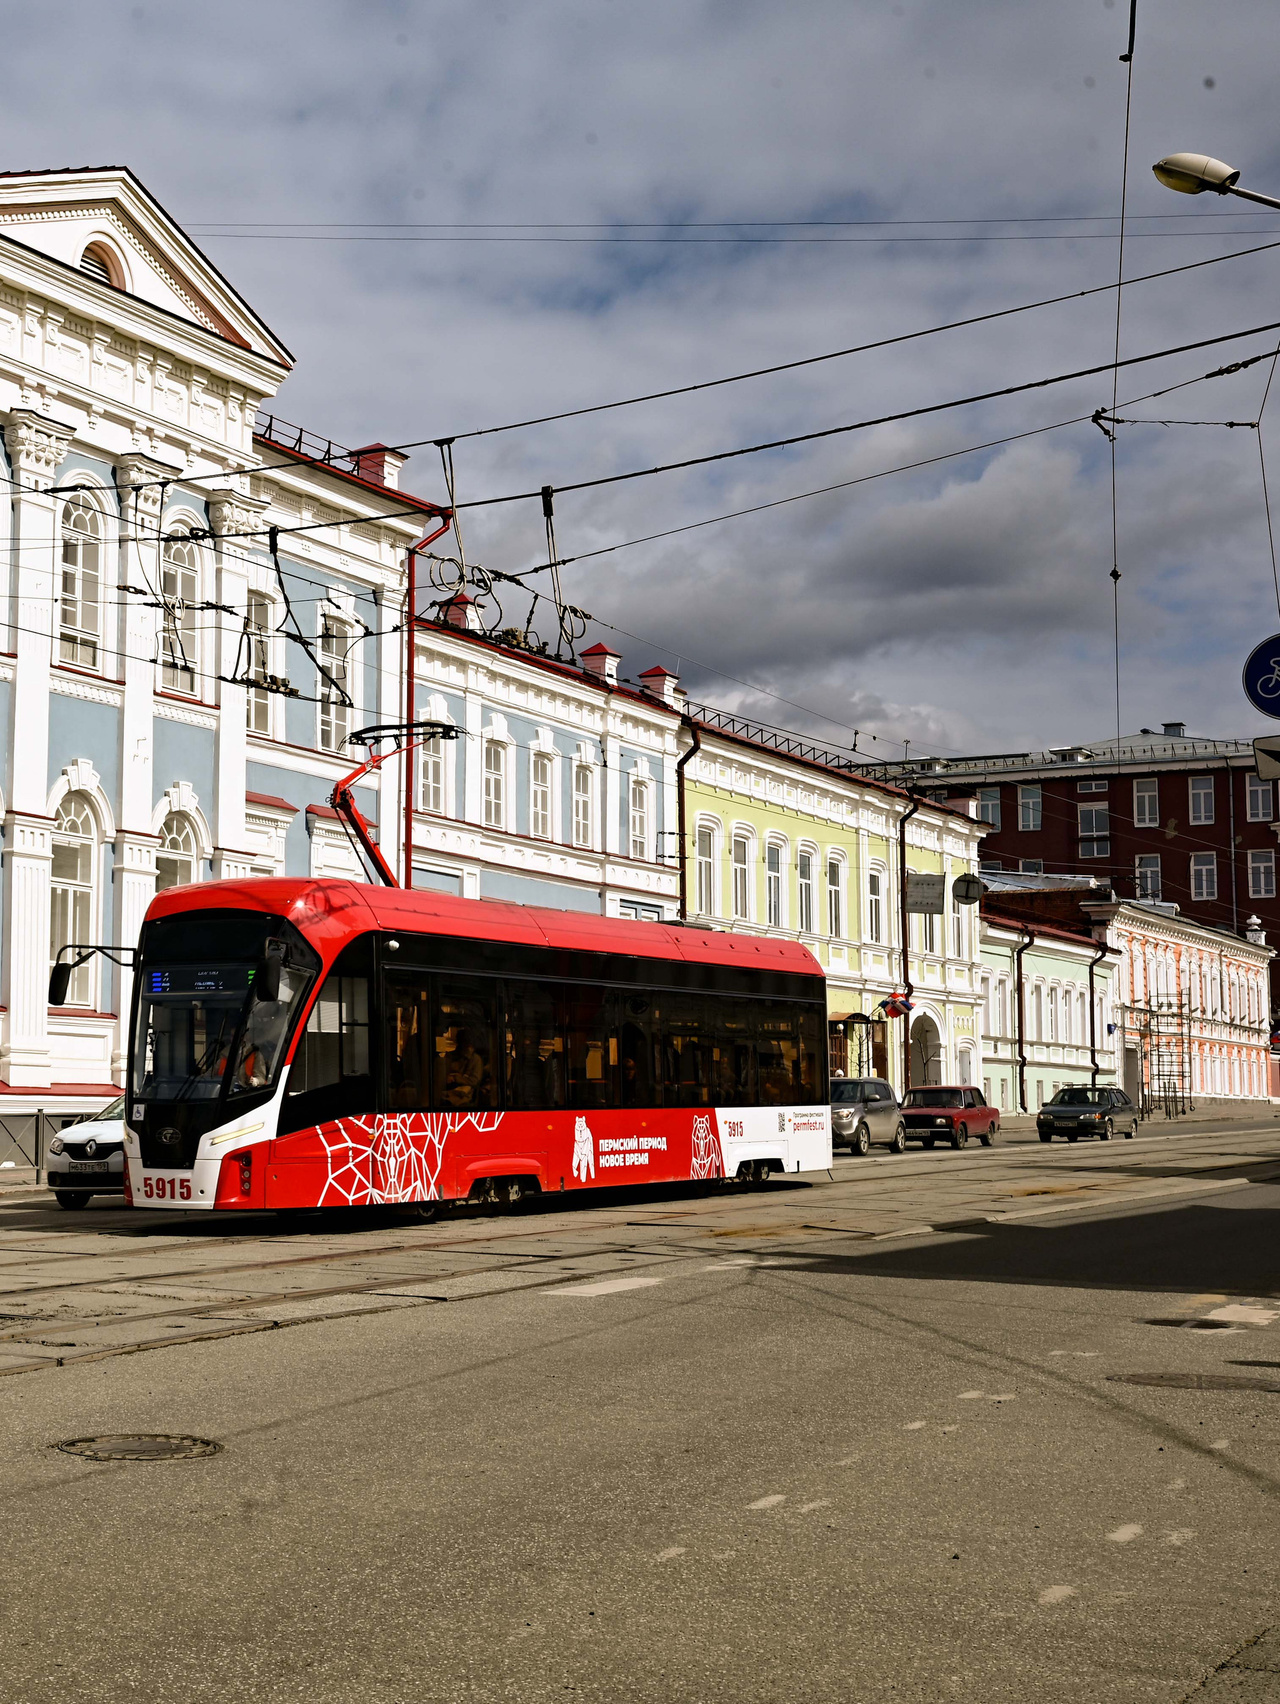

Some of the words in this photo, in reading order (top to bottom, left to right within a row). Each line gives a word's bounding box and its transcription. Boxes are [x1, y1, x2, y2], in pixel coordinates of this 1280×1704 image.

[728, 1121, 744, 1137] 5915
[793, 1119, 824, 1134] permfest.ru
[599, 1135, 638, 1152] ПЕРМСКИЙ
[639, 1137, 667, 1151] ПЕРИОД
[599, 1154, 624, 1168] НОВОЕ
[625, 1152, 649, 1166] ВРЕМЯ
[143, 1176, 192, 1200] 5915
